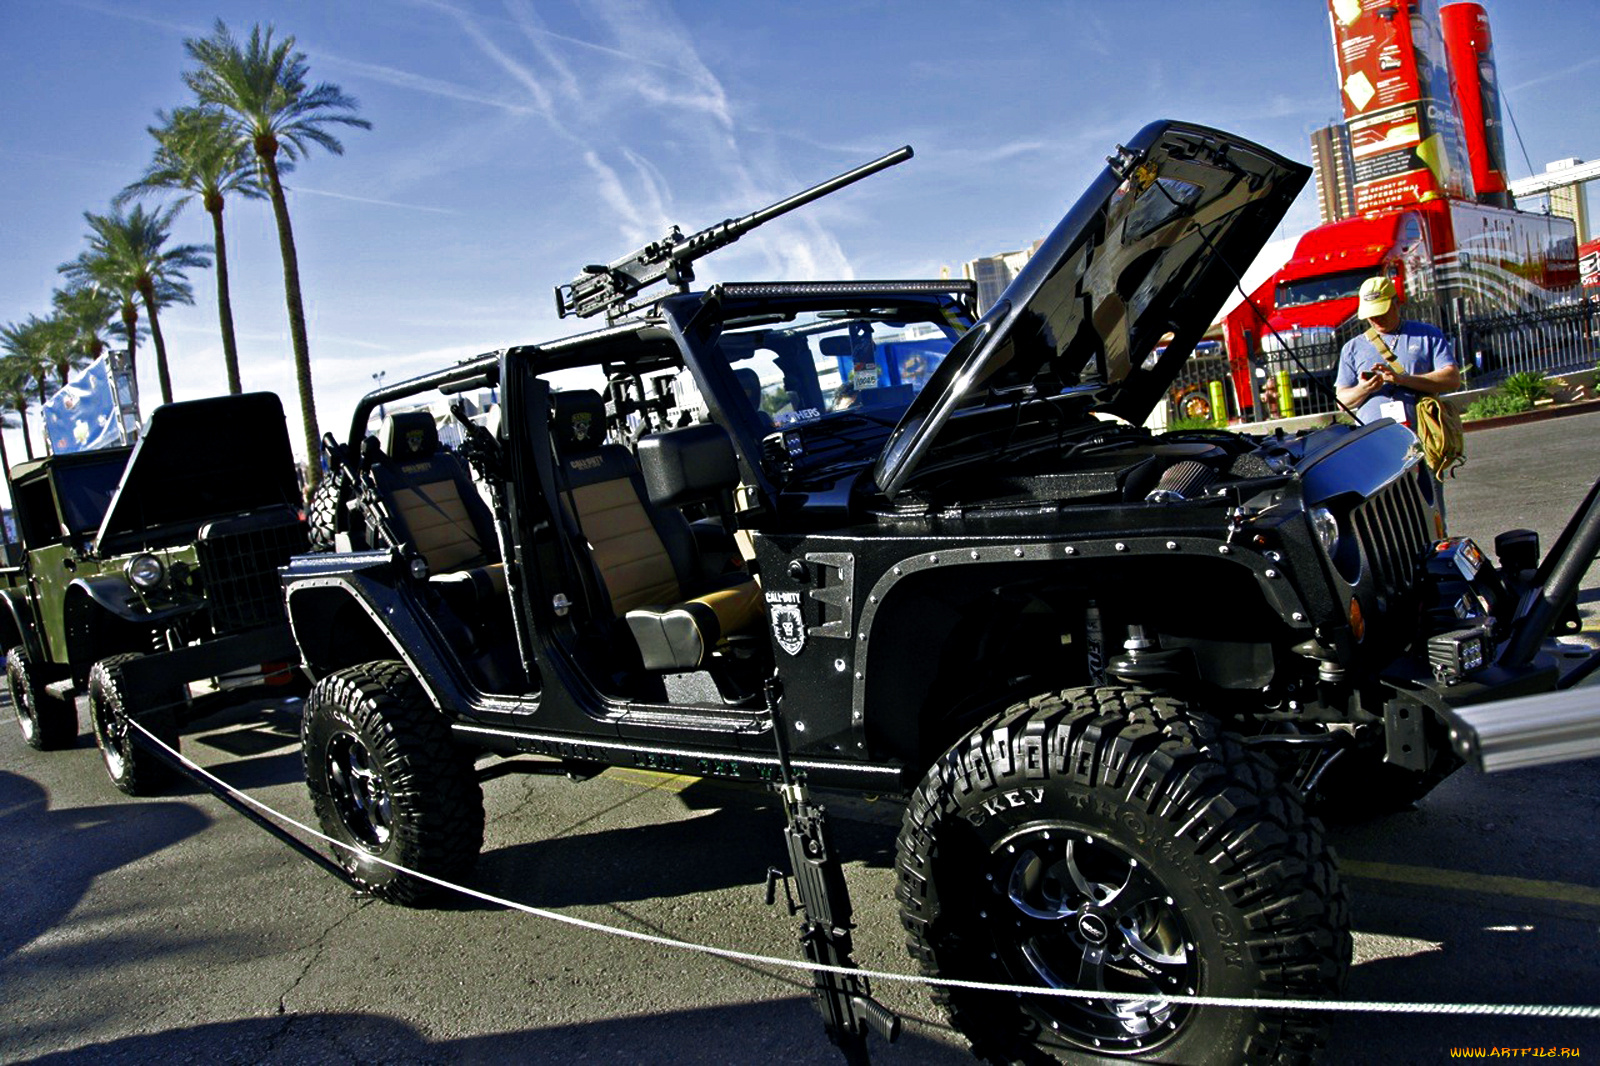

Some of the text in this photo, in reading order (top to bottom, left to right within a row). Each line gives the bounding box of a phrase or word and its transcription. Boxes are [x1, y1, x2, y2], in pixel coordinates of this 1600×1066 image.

[1357, 184, 1419, 203] PROFESSIONAL
[1370, 182, 1396, 193] SECRET
[1358, 195, 1403, 210] DETAILERS
[965, 786, 1244, 970] CKEY THOMPSON
